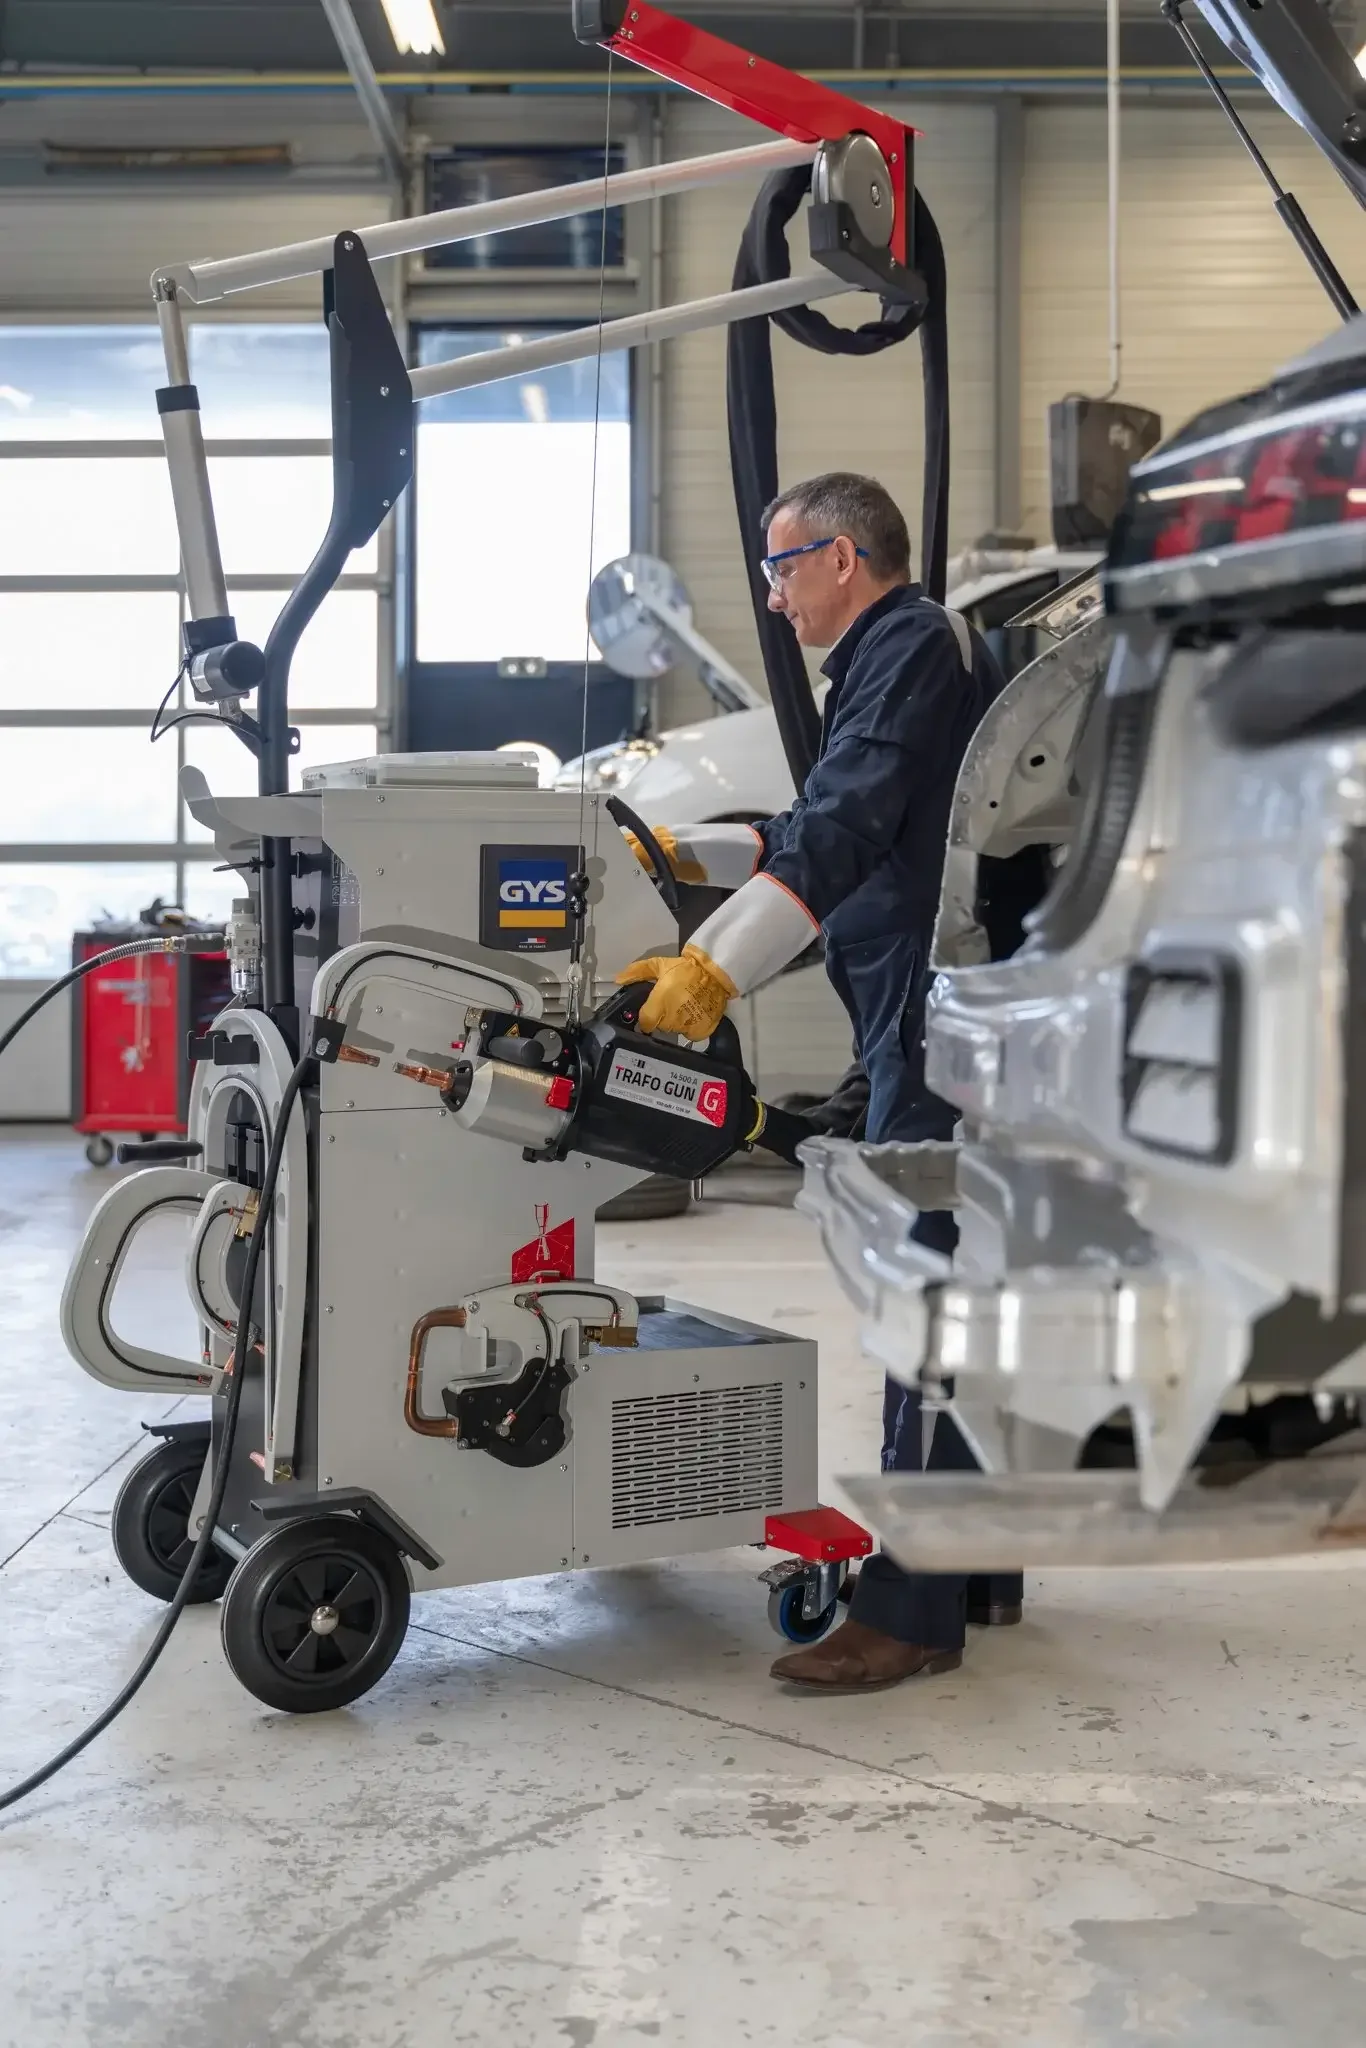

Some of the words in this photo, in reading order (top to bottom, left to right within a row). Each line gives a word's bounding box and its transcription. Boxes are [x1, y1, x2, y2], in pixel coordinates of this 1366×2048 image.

[500, 880, 566, 903] GYS
[615, 1065, 661, 1091] TRAFO
[664, 1081, 696, 1102] GUN
[669, 1072, 678, 1080] 14
[679, 1073, 692, 1084] 500
[692, 1077, 698, 1085] A
[703, 1087, 721, 1112] G
